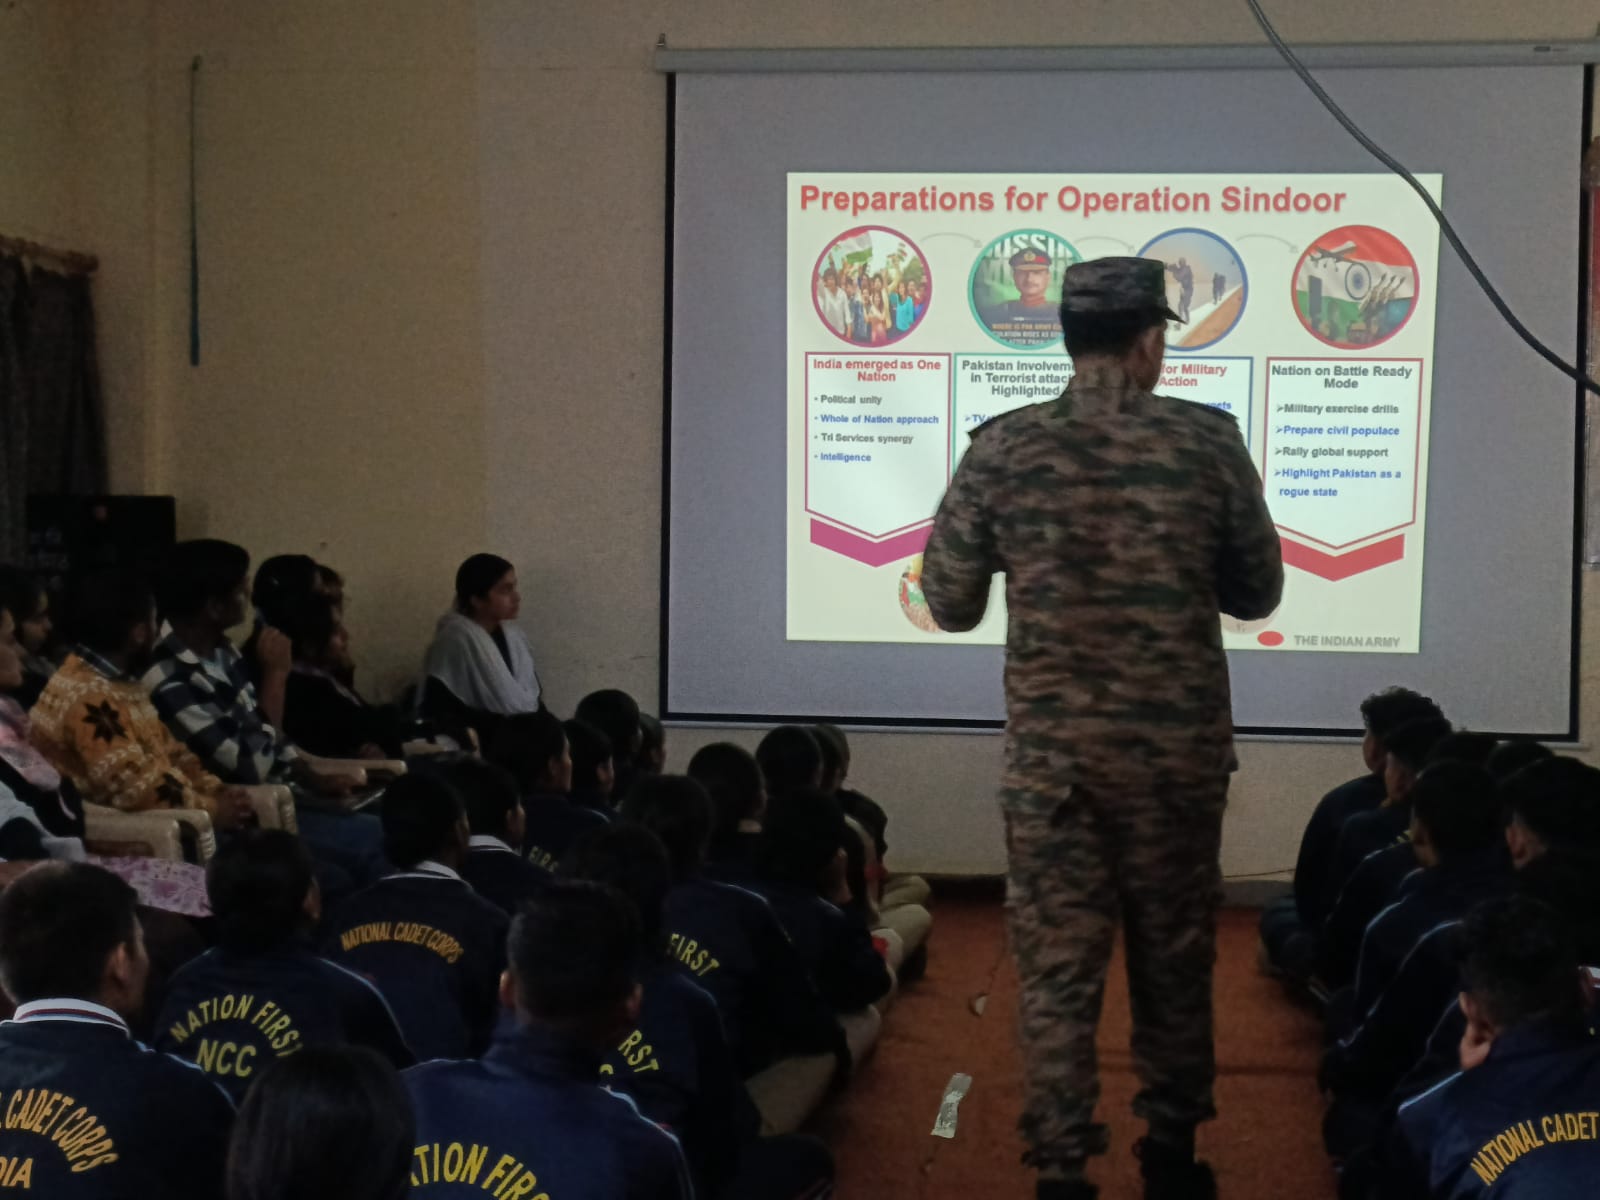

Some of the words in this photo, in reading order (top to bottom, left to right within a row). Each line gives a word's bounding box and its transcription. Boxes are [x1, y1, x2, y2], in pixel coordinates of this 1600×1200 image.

[800, 185, 994, 217] Preparations
[1004, 185, 1048, 211] for
[1057, 185, 1211, 218] Operation
[1221, 186, 1347, 213] Sindoor
[813, 359, 842, 370] India
[845, 360, 898, 371] emerged
[900, 361, 914, 369] as
[917, 360, 941, 370] One
[962, 360, 1013, 371] Pakistan
[1181, 364, 1227, 377] Military
[857, 371, 896, 382] Nation
[1271, 365, 1312, 376] Nation
[1315, 367, 1331, 376] on
[1333, 366, 1369, 377] Battle
[1373, 366, 1412, 379] Ready
[970, 373, 981, 383] in
[986, 373, 1036, 384] Terrorist
[1324, 378, 1359, 389] Mode
[991, 385, 1060, 398] Highlighted
[820, 395, 856, 404] Political
[860, 396, 882, 405] unity
[1284, 404, 1323, 415] Military
[1325, 405, 1369, 414] exercise
[1371, 405, 1399, 414] drills
[820, 414, 849, 423] Whole
[852, 415, 861, 423] of
[864, 415, 893, 423] Nation
[896, 416, 939, 425] approach
[1283, 425, 1324, 436] Prepare
[1327, 426, 1349, 435] civil
[1351, 427, 1400, 437] populace
[821, 433, 833, 442] Tri
[835, 433, 874, 443] Services
[878, 435, 914, 444] synergy
[820, 452, 872, 463] Intelligence
[1282, 447, 1309, 458] Rally
[1311, 448, 1344, 458] global
[1346, 448, 1389, 459] support
[1281, 468, 1330, 480] Highlight
[1332, 469, 1377, 479] Pakistan
[1279, 488, 1310, 498] rogue
[1312, 488, 1338, 497] state
[1293, 635, 1318, 646] THE
[1321, 635, 1363, 647] INDIAN
[1365, 636, 1401, 648] ARMY
[340, 921, 393, 952] NATIONAL
[393, 921, 433, 946] CADET
[426, 929, 465, 964] CORPS
[169, 994, 255, 1043] NATION
[617, 1029, 660, 1073] RST
[196, 1038, 257, 1077] NCC
[5, 1088, 75, 1136] CADET
[51, 1106, 120, 1173] CORPS
[1470, 1119, 1545, 1187] NATIONAL
[1541, 1111, 1600, 1143] CADET
[410, 1141, 489, 1187] TION
[480, 1153, 551, 1200] FIR
